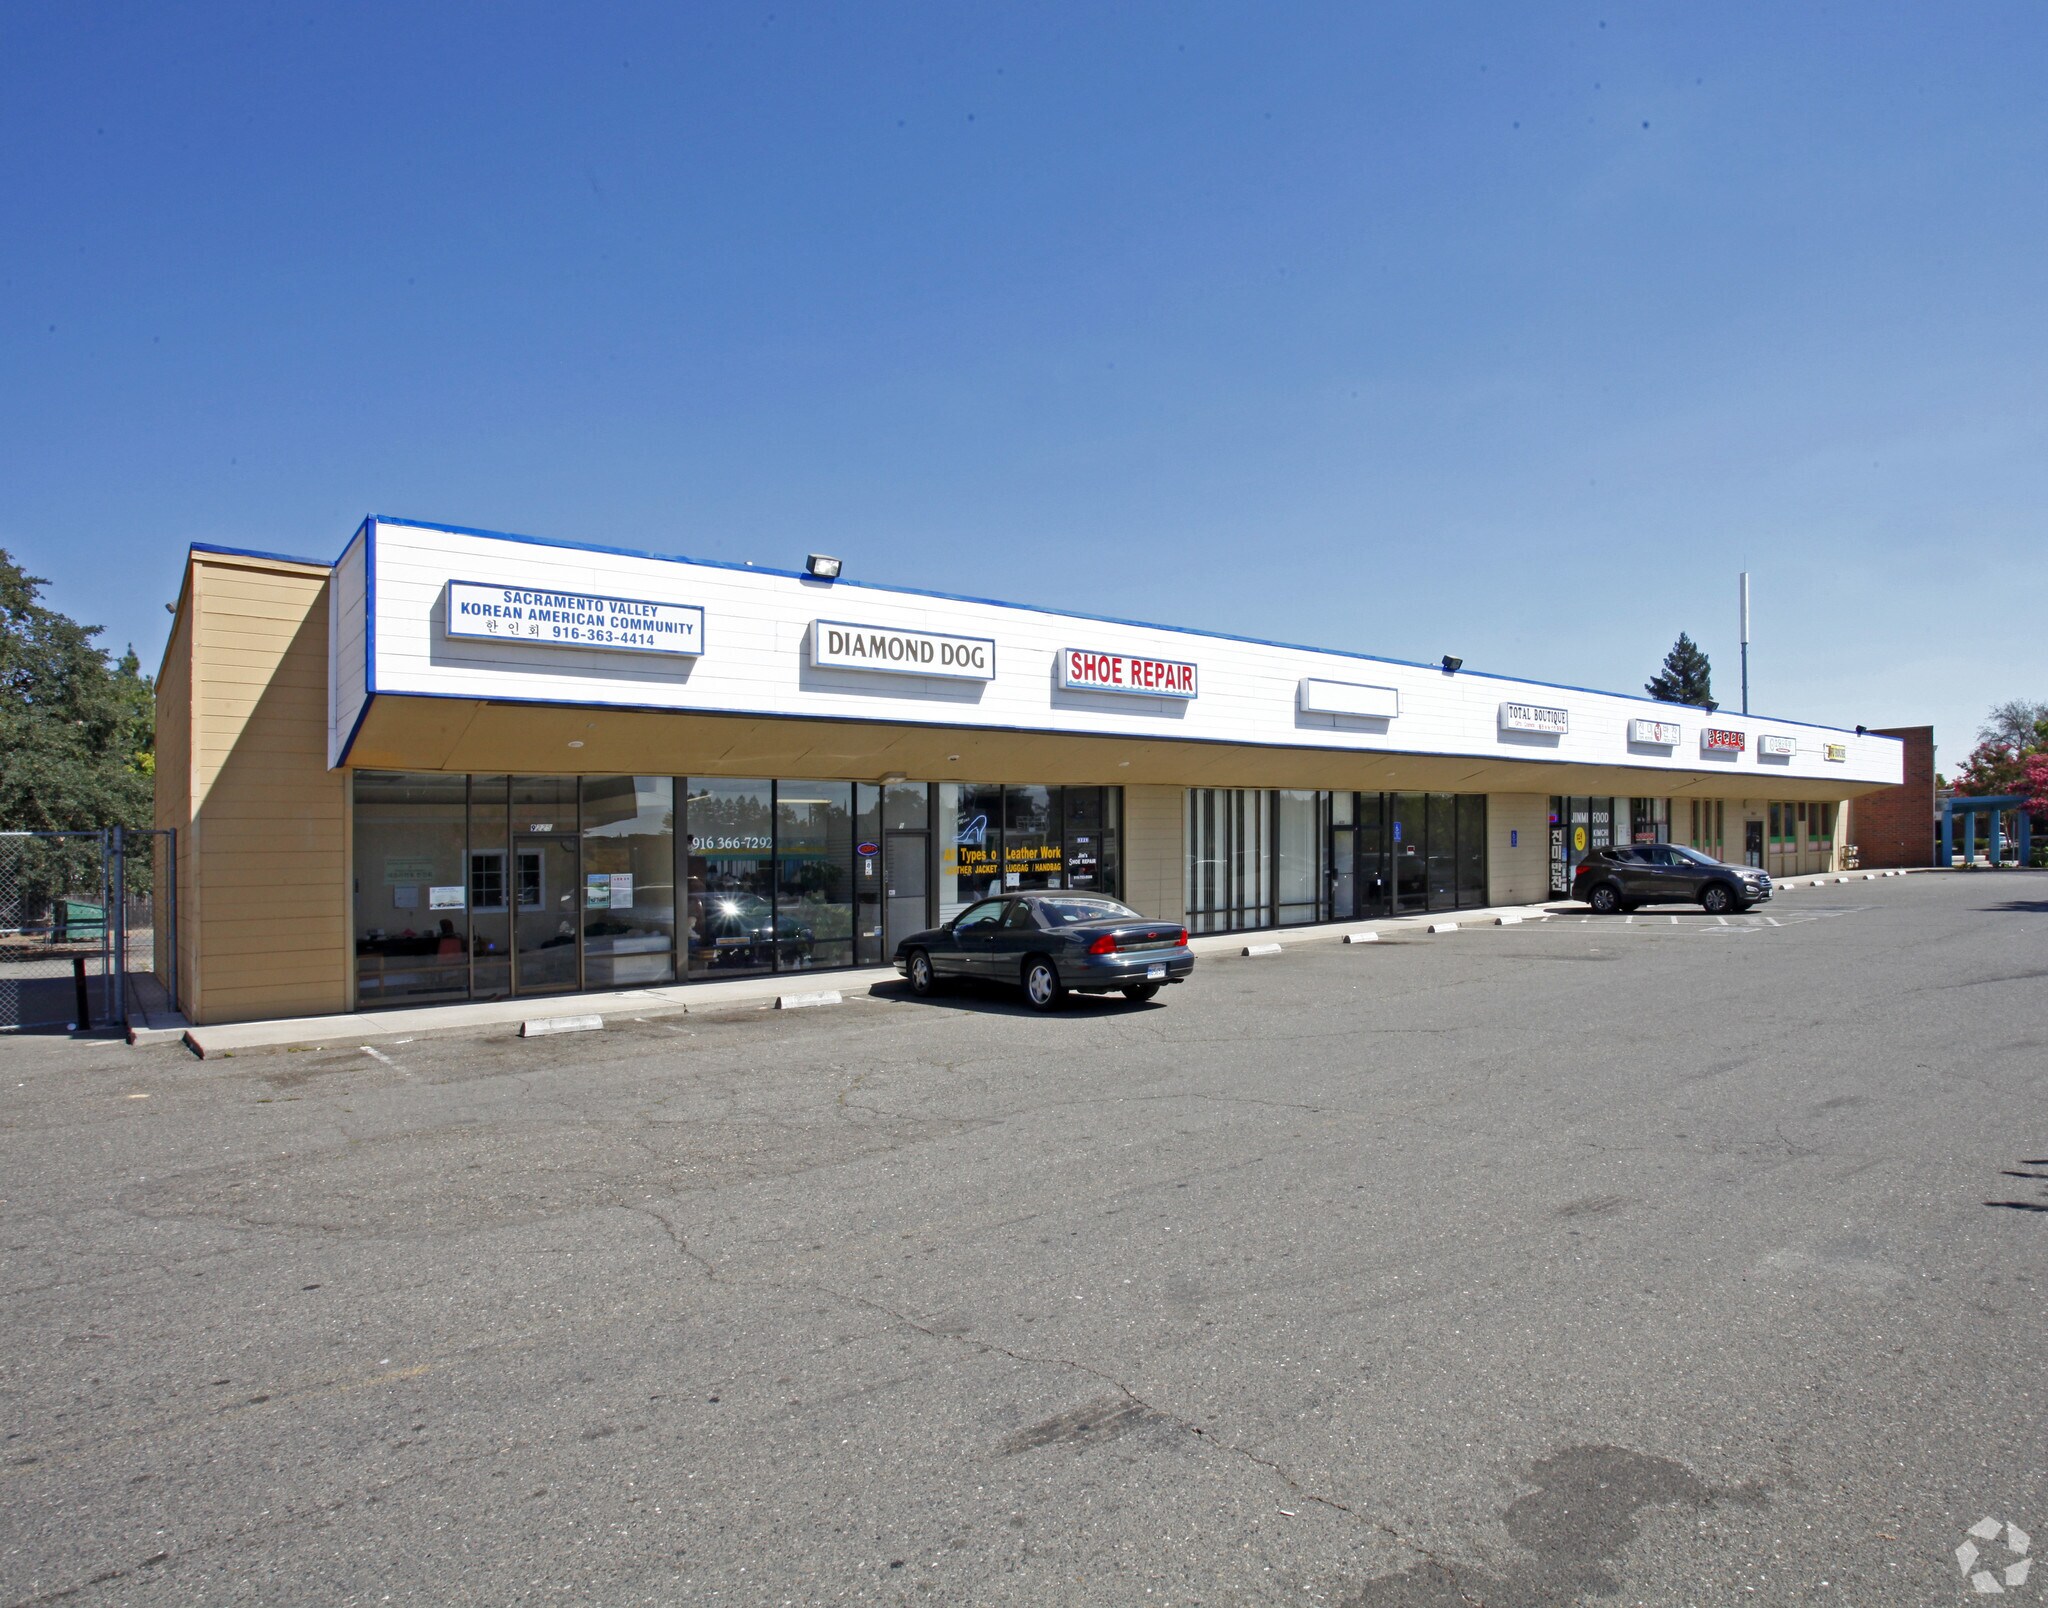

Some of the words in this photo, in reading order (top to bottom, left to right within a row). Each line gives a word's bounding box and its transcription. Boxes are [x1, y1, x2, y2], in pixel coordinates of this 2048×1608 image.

[503, 590, 604, 612] SACRAMENTO
[609, 602, 658, 618] VALLEY
[460, 601, 523, 619] KOREAN
[528, 608, 605, 627] AMERICAN
[610, 616, 694, 635] COMMUNITY
[552, 625, 655, 646] 916-363-4414
[828, 630, 934, 664] DIAMOND
[940, 643, 985, 669] DOG
[1071, 651, 1123, 684] SHOE
[1131, 659, 1193, 691] REPAIR
[1508, 705, 1531, 721] TOTAL
[1534, 709, 1566, 726] BOUTIQUE
[1571, 812, 1589, 824] JINMI
[1592, 812, 1609, 824] FOOD
[692, 836, 714, 850] 916
[719, 836, 773, 850] 366-7292
[960, 848, 987, 864] Types
[1005, 846, 1038, 861] Leather
[1040, 846, 1061, 860] Work
